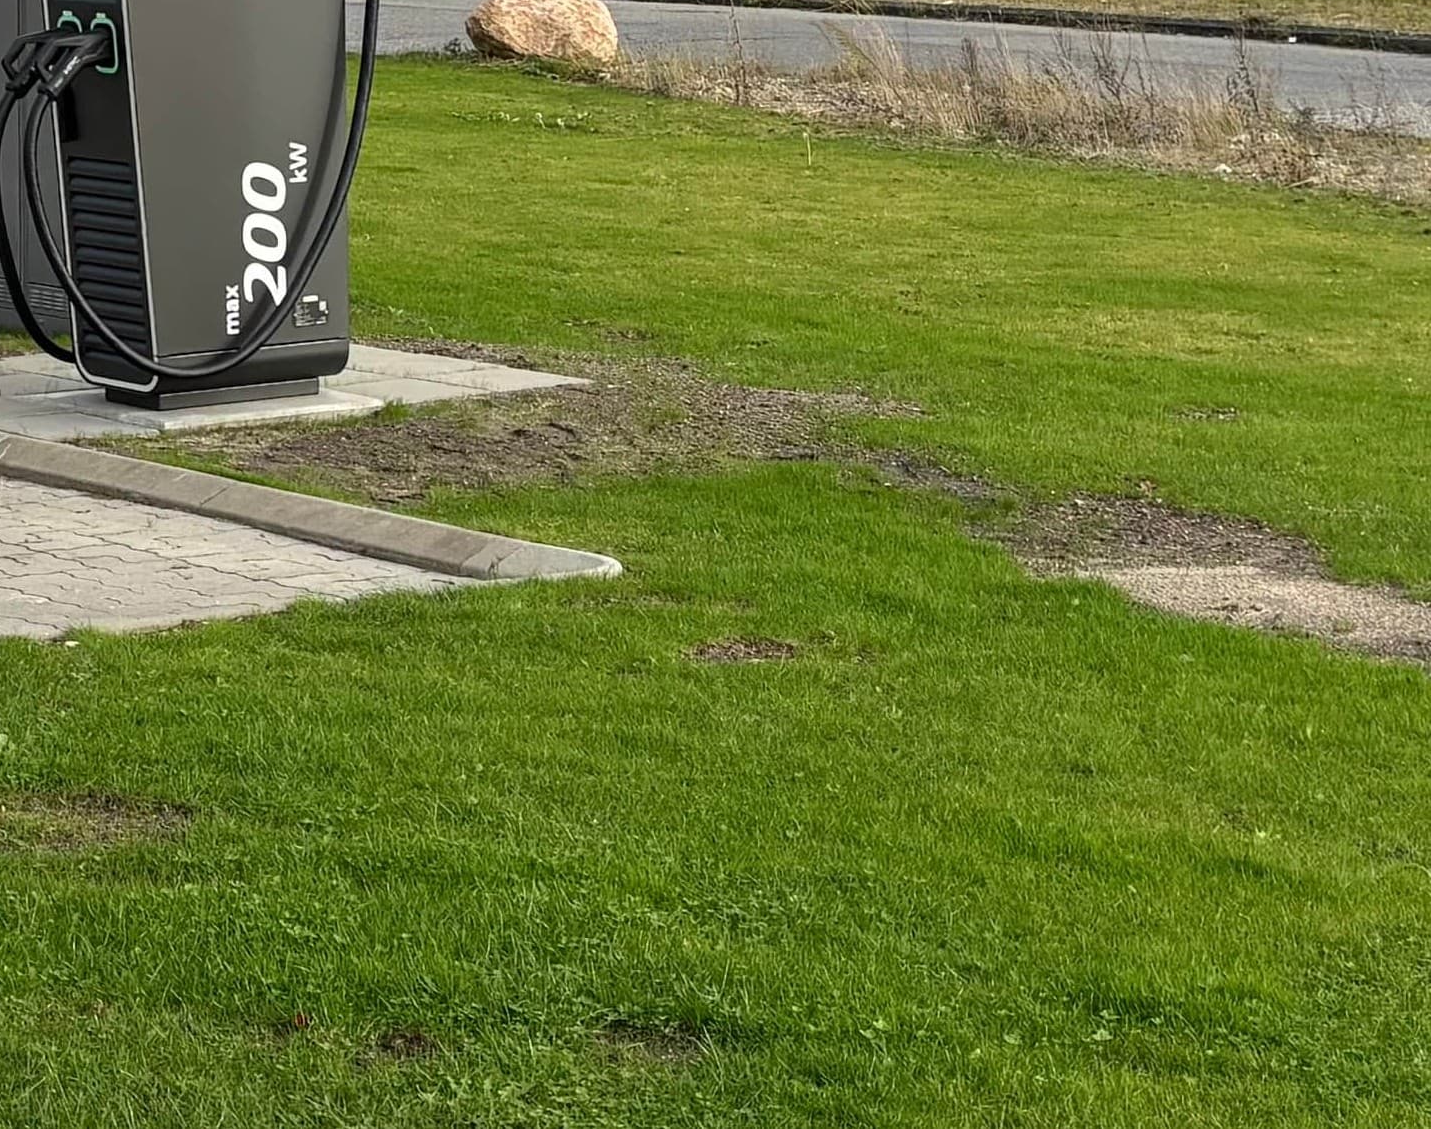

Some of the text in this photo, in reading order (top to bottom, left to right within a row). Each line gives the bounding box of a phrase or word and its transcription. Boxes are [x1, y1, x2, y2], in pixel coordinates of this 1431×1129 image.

[289, 142, 308, 183] kW
[242, 162, 287, 306] 200
[225, 284, 240, 335] max
